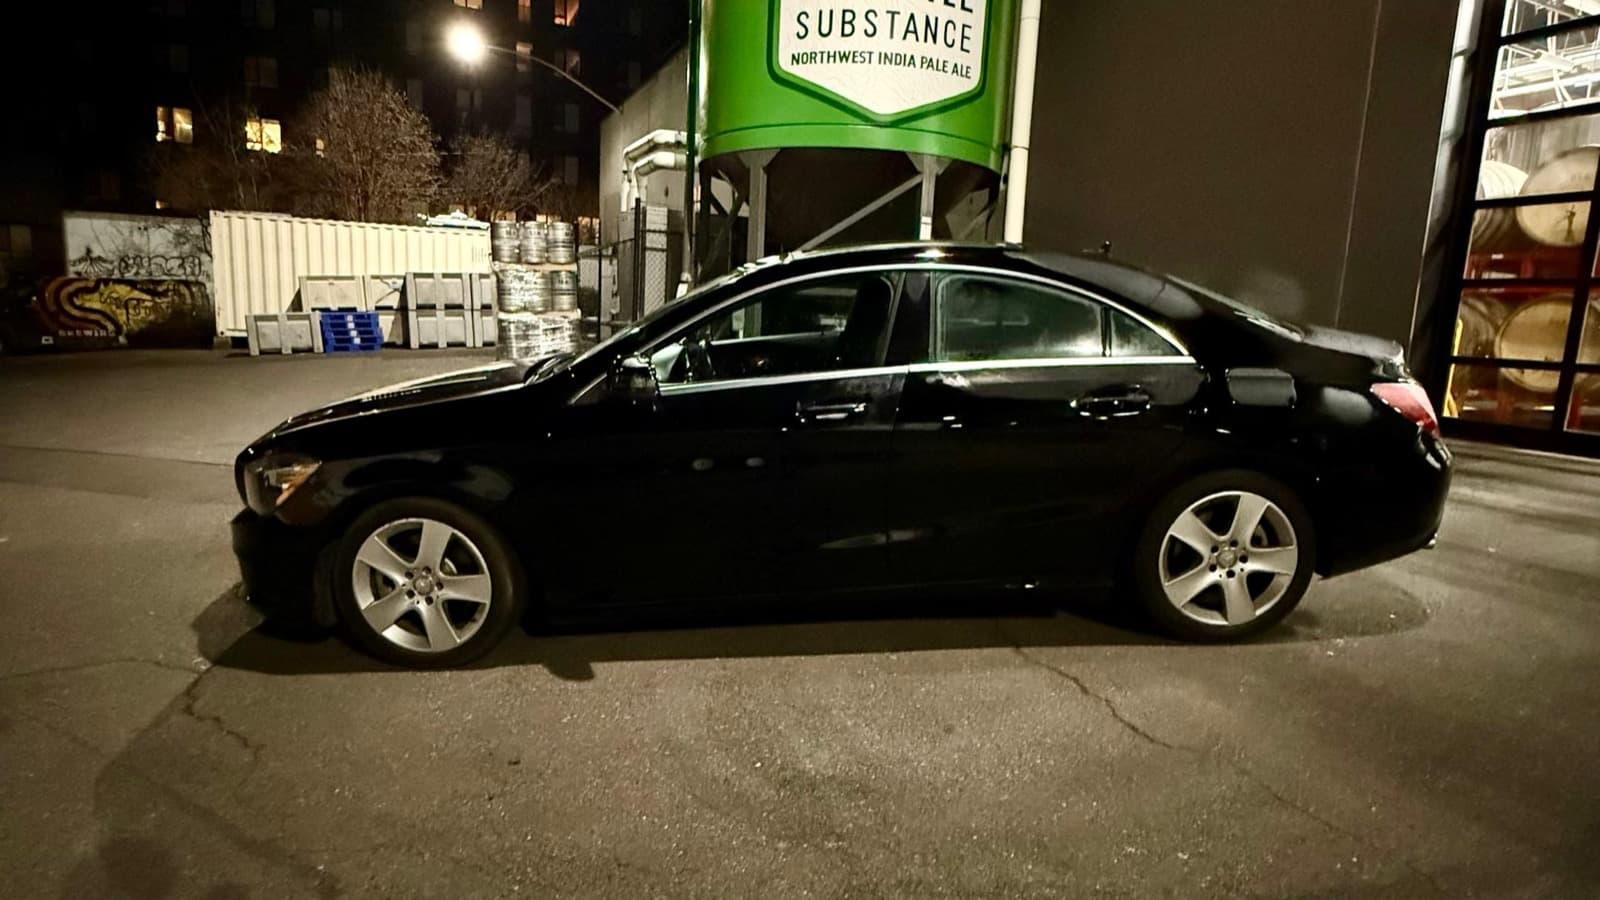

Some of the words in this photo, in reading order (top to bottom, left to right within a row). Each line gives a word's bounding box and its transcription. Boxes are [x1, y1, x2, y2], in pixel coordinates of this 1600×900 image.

[796, 9, 972, 54] SUBSTANCE
[791, 50, 874, 66] NORTHWEST
[878, 52, 917, 68] INDIA
[920, 56, 949, 74] PALE
[951, 62, 972, 80] ALE
